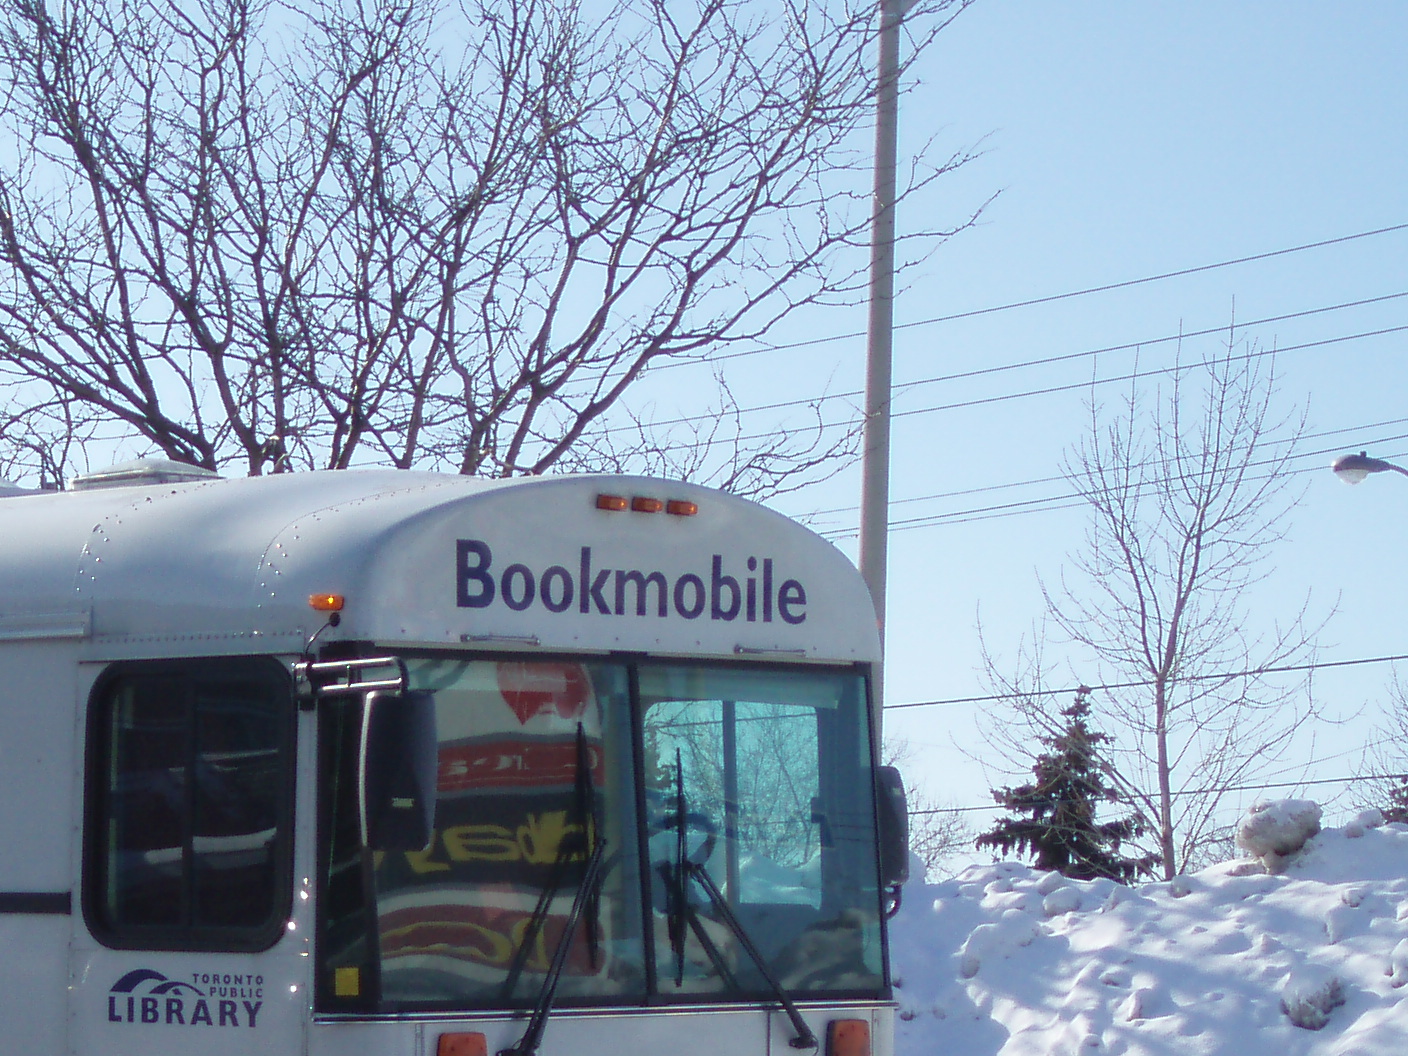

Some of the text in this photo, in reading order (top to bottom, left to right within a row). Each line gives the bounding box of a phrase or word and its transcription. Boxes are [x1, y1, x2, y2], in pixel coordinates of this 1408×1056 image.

[455, 538, 807, 625] Bookmobile
[192, 973, 264, 985] TORONTO
[209, 986, 263, 997] PUBLIC
[108, 996, 263, 1028] LIBRARY
